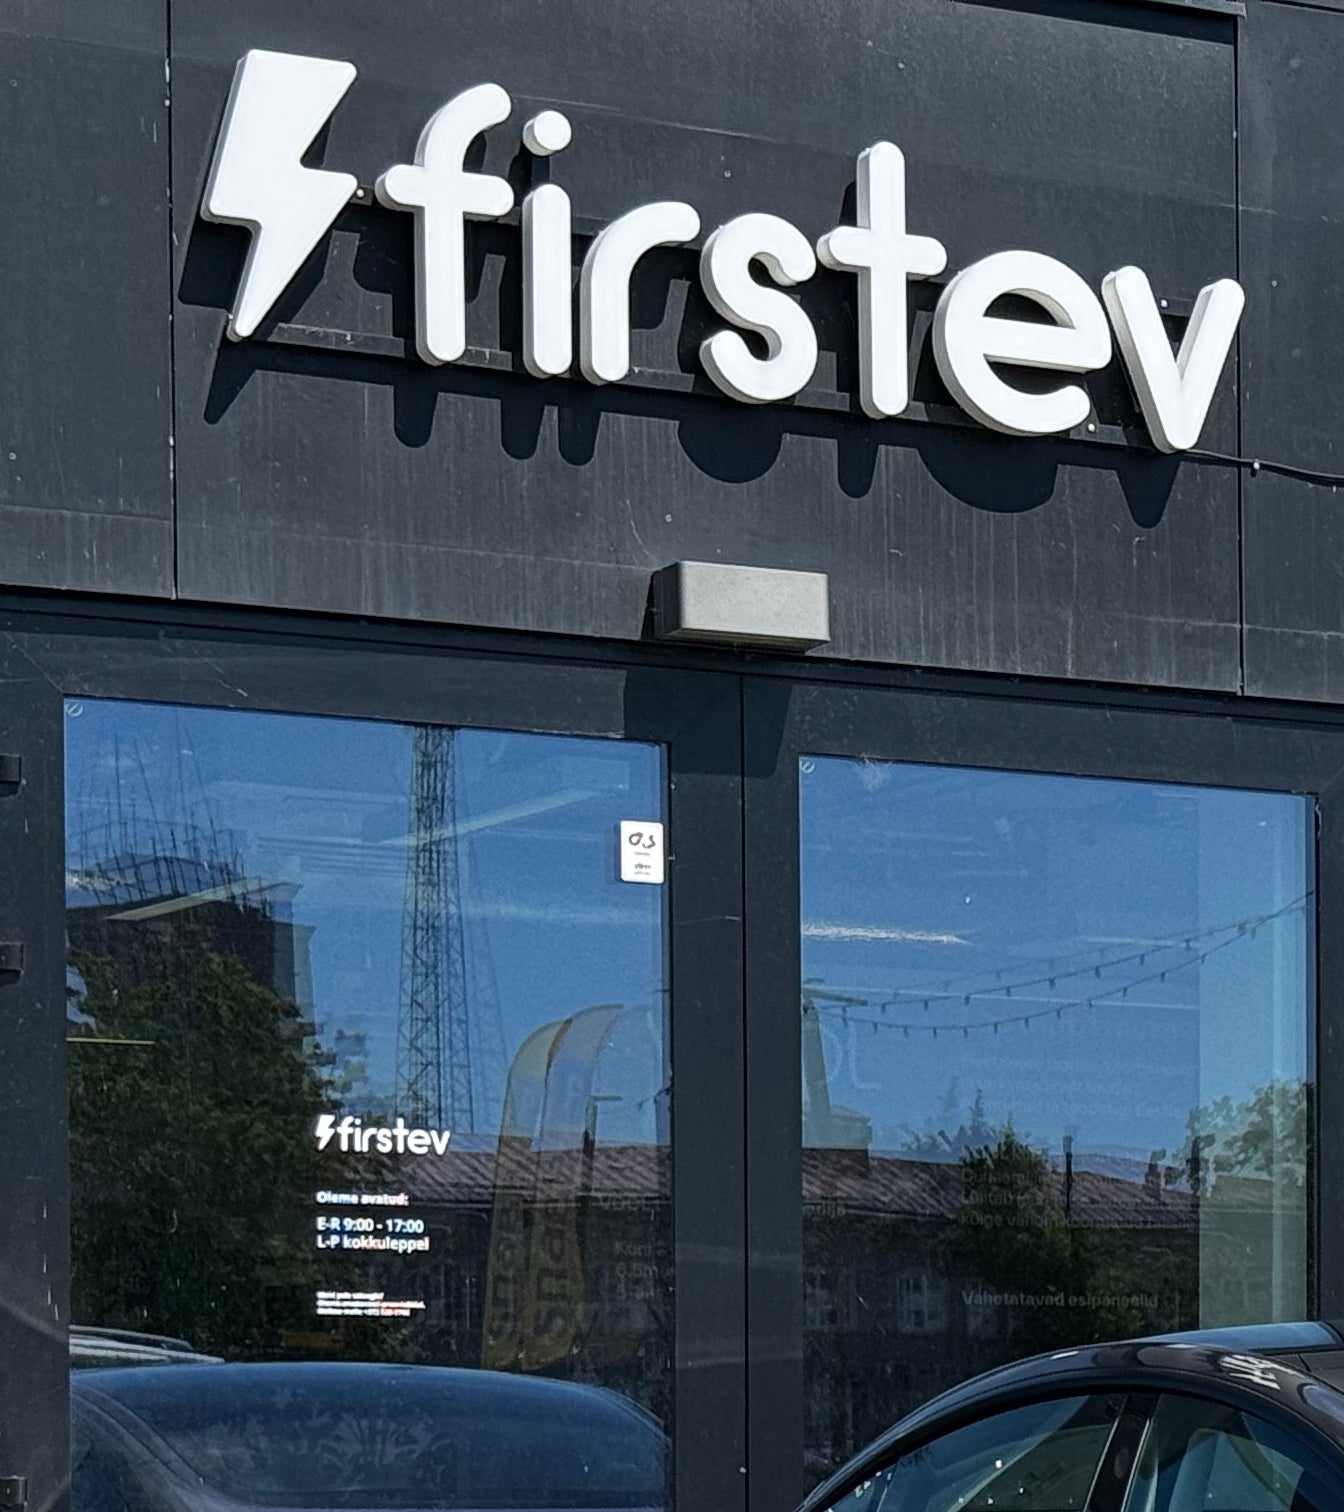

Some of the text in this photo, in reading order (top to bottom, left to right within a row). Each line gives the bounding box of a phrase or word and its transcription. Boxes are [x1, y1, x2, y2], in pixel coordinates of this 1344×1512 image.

[375, 83, 1246, 454] firstev
[336, 1115, 451, 1156] firstev
[316, 1191, 410, 1207] Oleme avatud:
[316, 1216, 341, 1231] E-R
[343, 1218, 375, 1232] 9:00
[385, 1220, 425, 1234] 17:00
[316, 1235, 430, 1254] L-P kokkuleppel
